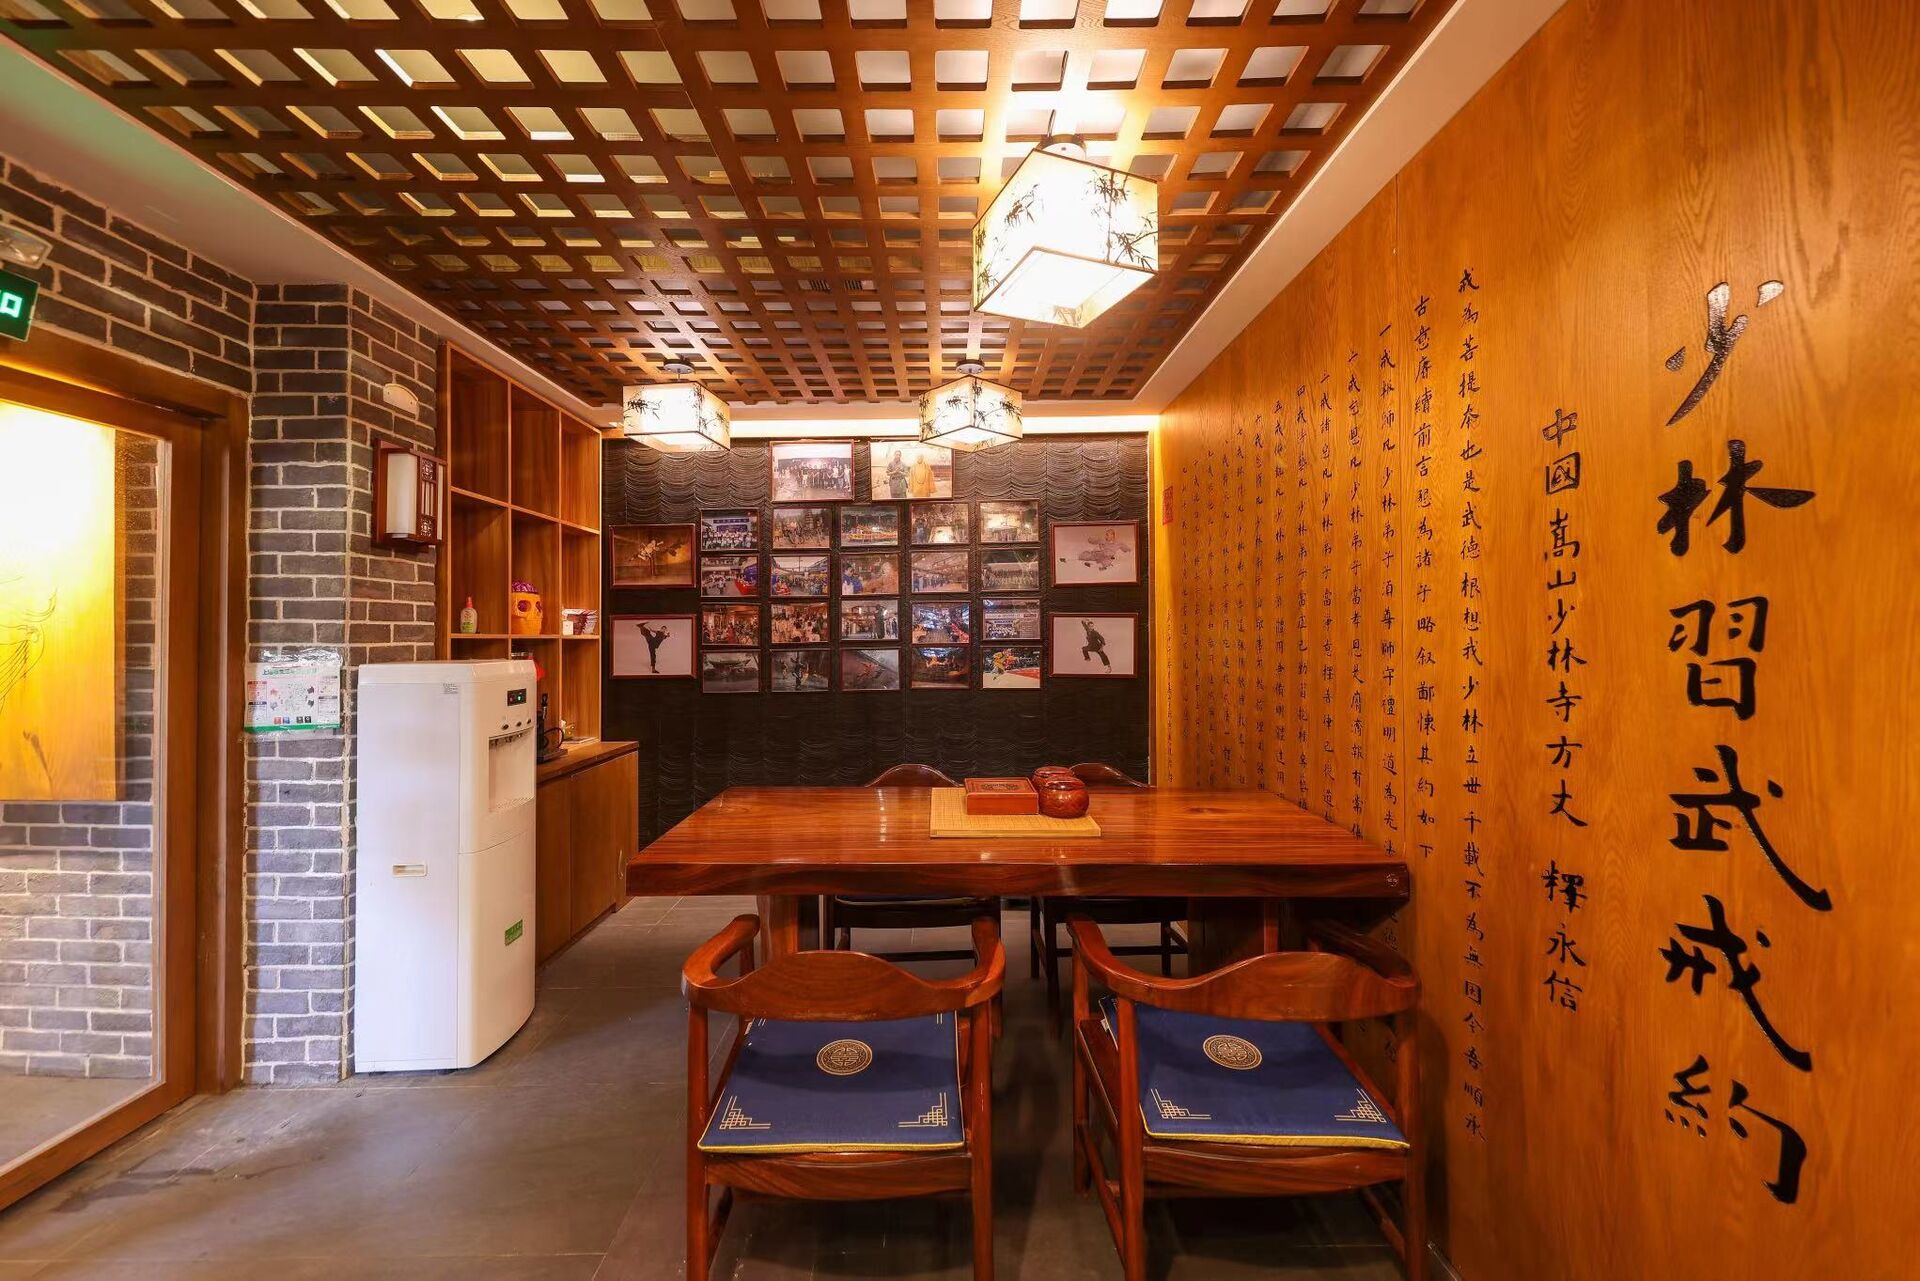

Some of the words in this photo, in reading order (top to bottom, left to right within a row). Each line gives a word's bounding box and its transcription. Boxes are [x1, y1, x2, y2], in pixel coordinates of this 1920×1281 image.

[1541, 860, 1588, 1012] 釋永信
[1657, 279, 1832, 1205] 少林習武戒約
